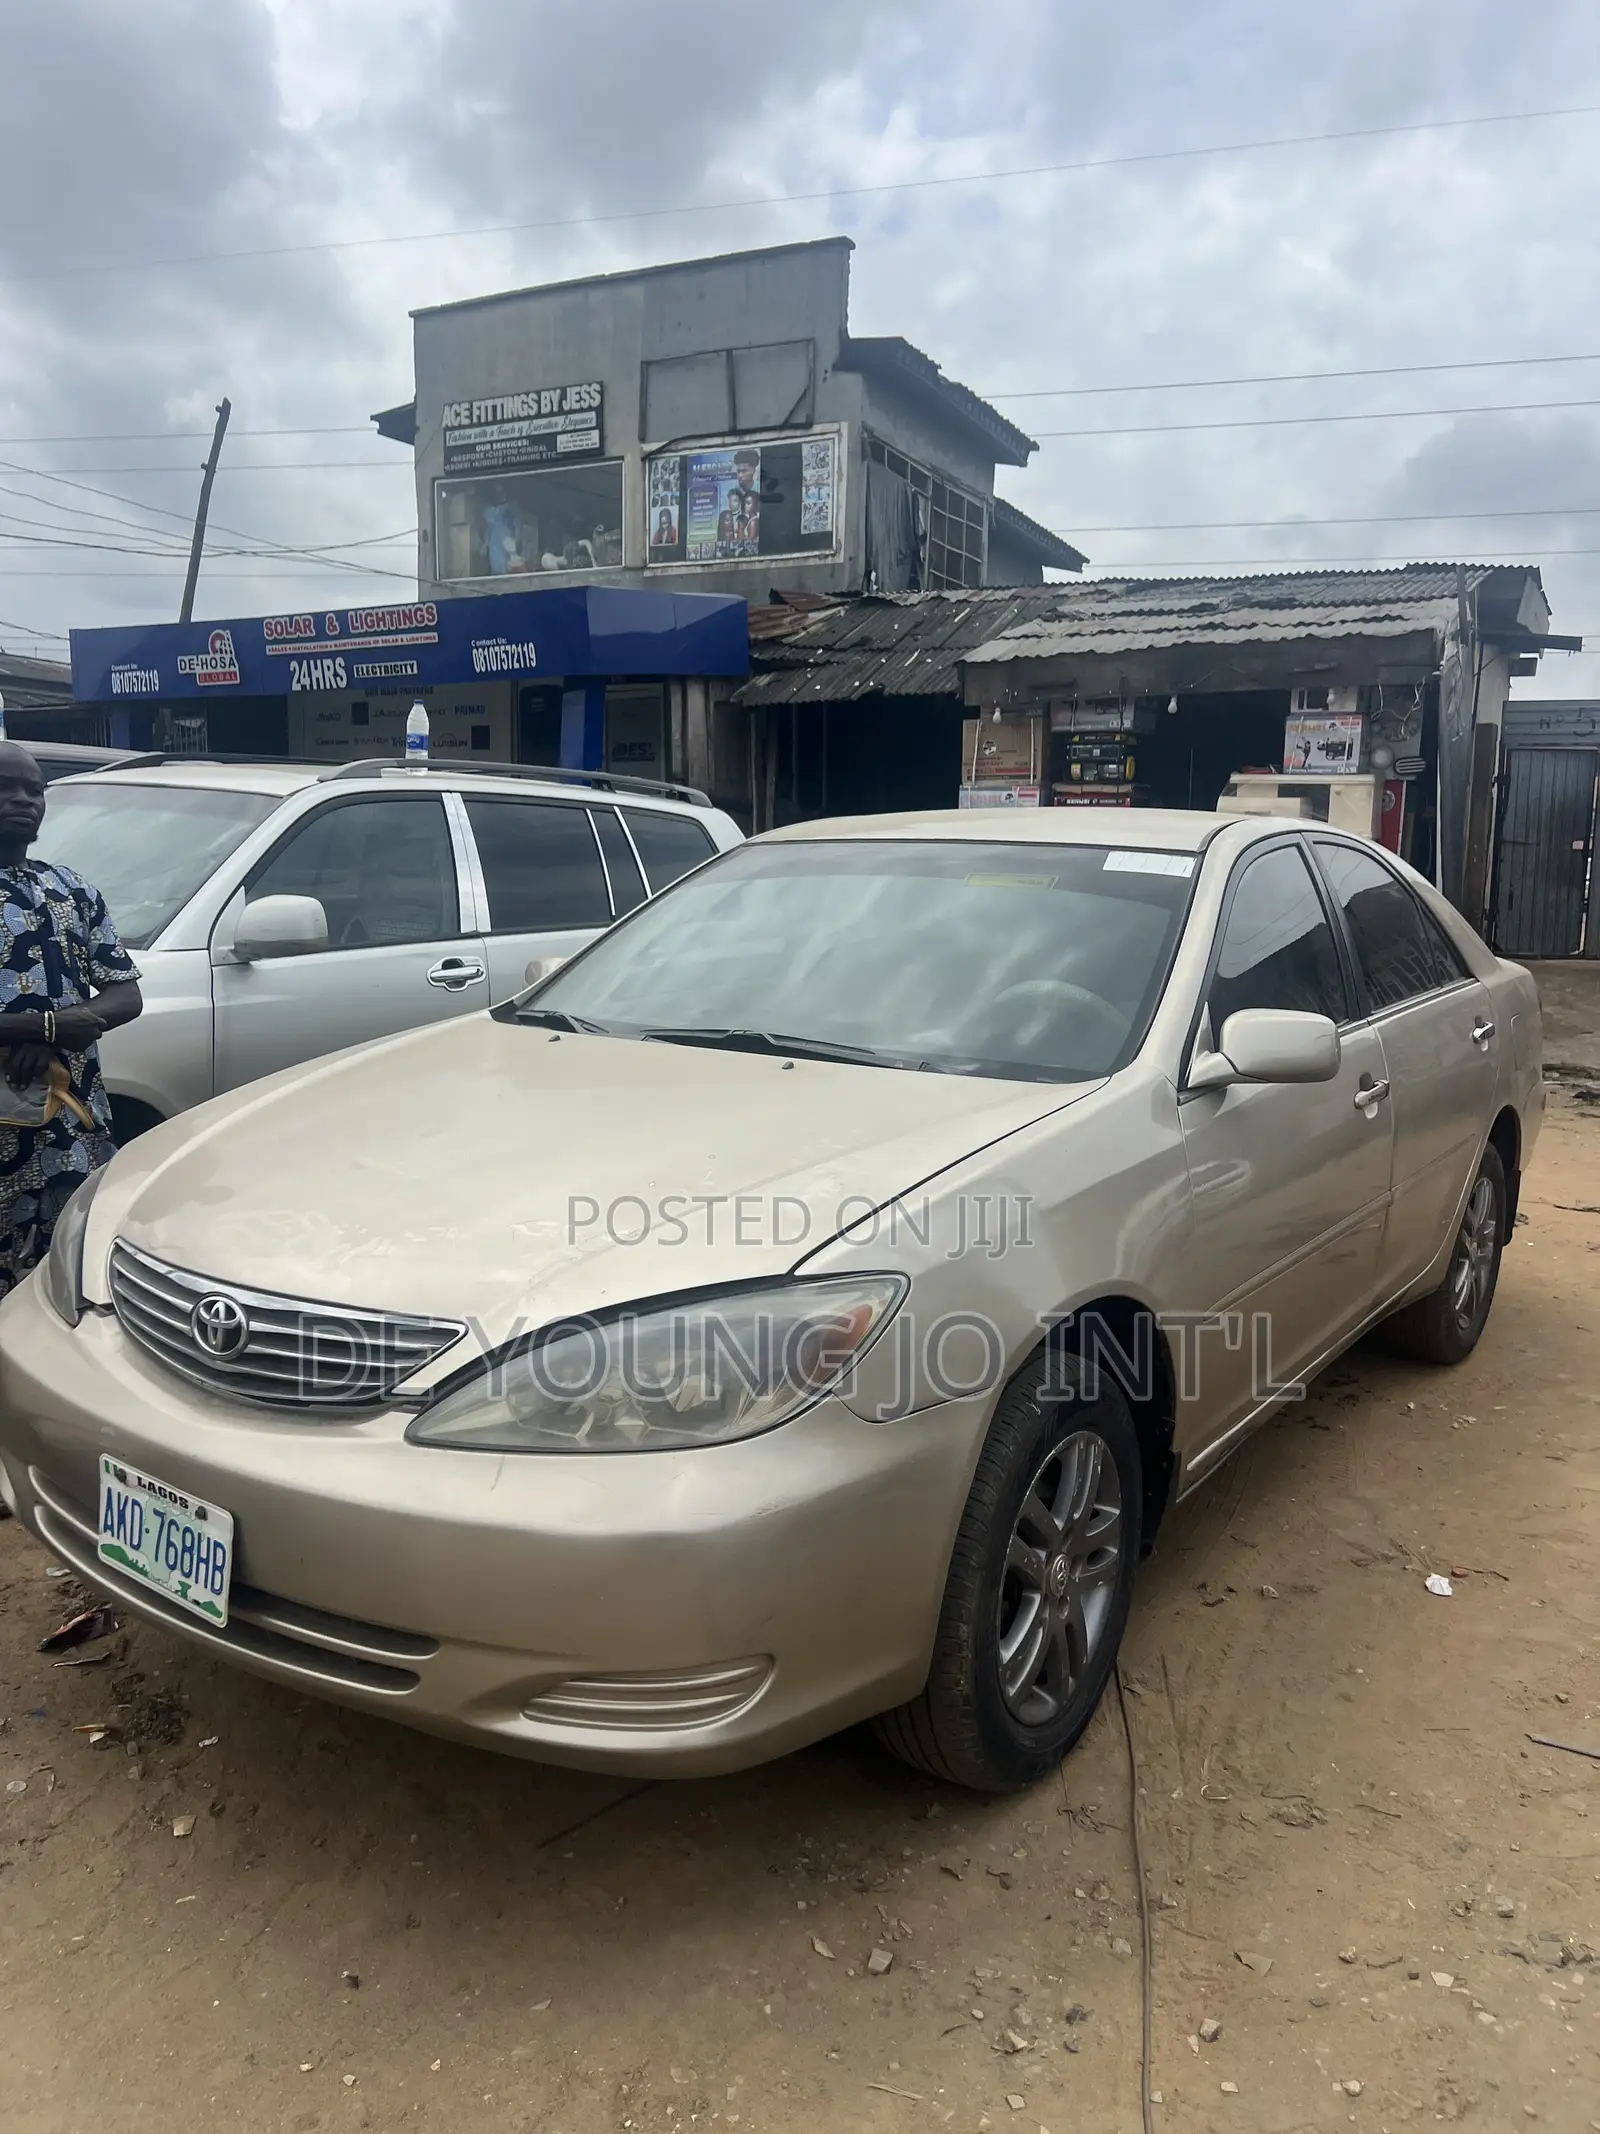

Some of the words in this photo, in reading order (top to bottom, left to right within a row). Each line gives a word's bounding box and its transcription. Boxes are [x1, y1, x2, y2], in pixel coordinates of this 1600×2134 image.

[441, 402, 470, 428] ACE
[472, 392, 538, 423] FITTINGS
[540, 389, 561, 414] BY
[562, 382, 601, 411] JESS
[476, 443, 491, 452] OUR
[492, 439, 529, 450] SERVICES:
[264, 616, 315, 640] SOLAR
[326, 613, 340, 637] &
[348, 602, 438, 633] LIGHTINGS
[471, 638, 497, 647] Contact
[497, 637, 507, 645] Us:
[179, 655, 237, 672] DE-HOSA
[355, 662, 415, 677] ELECTRICITY
[472, 642, 537, 673] 08107572119
[111, 669, 159, 694] 08107572119
[199, 672, 236, 682] GLOBAL
[290, 656, 347, 691] 24HRS
[137, 1475, 189, 1510] LAGOS
